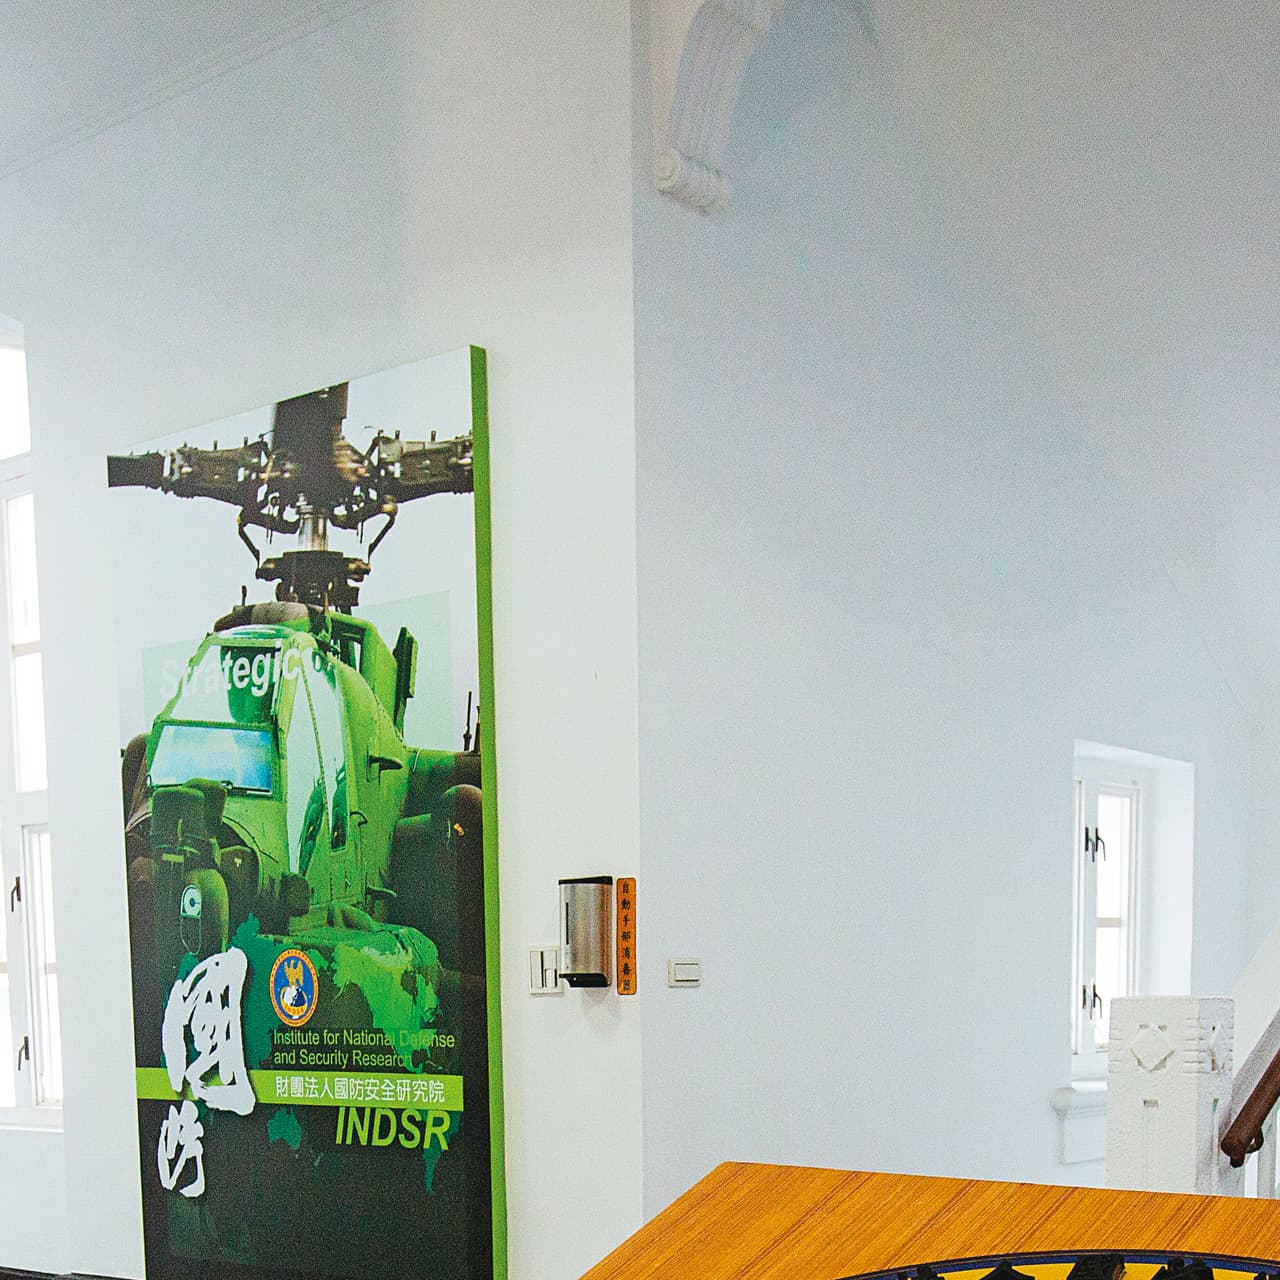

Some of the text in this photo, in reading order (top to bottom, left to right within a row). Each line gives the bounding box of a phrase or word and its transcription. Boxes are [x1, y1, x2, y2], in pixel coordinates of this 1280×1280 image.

[273, 1029, 455, 1048] Institute for National Defense
[273, 1050, 412, 1069] and Security Research
[275, 1076, 445, 1103] 財團法人國防安全研究院
[335, 1106, 451, 1150] INDSR
